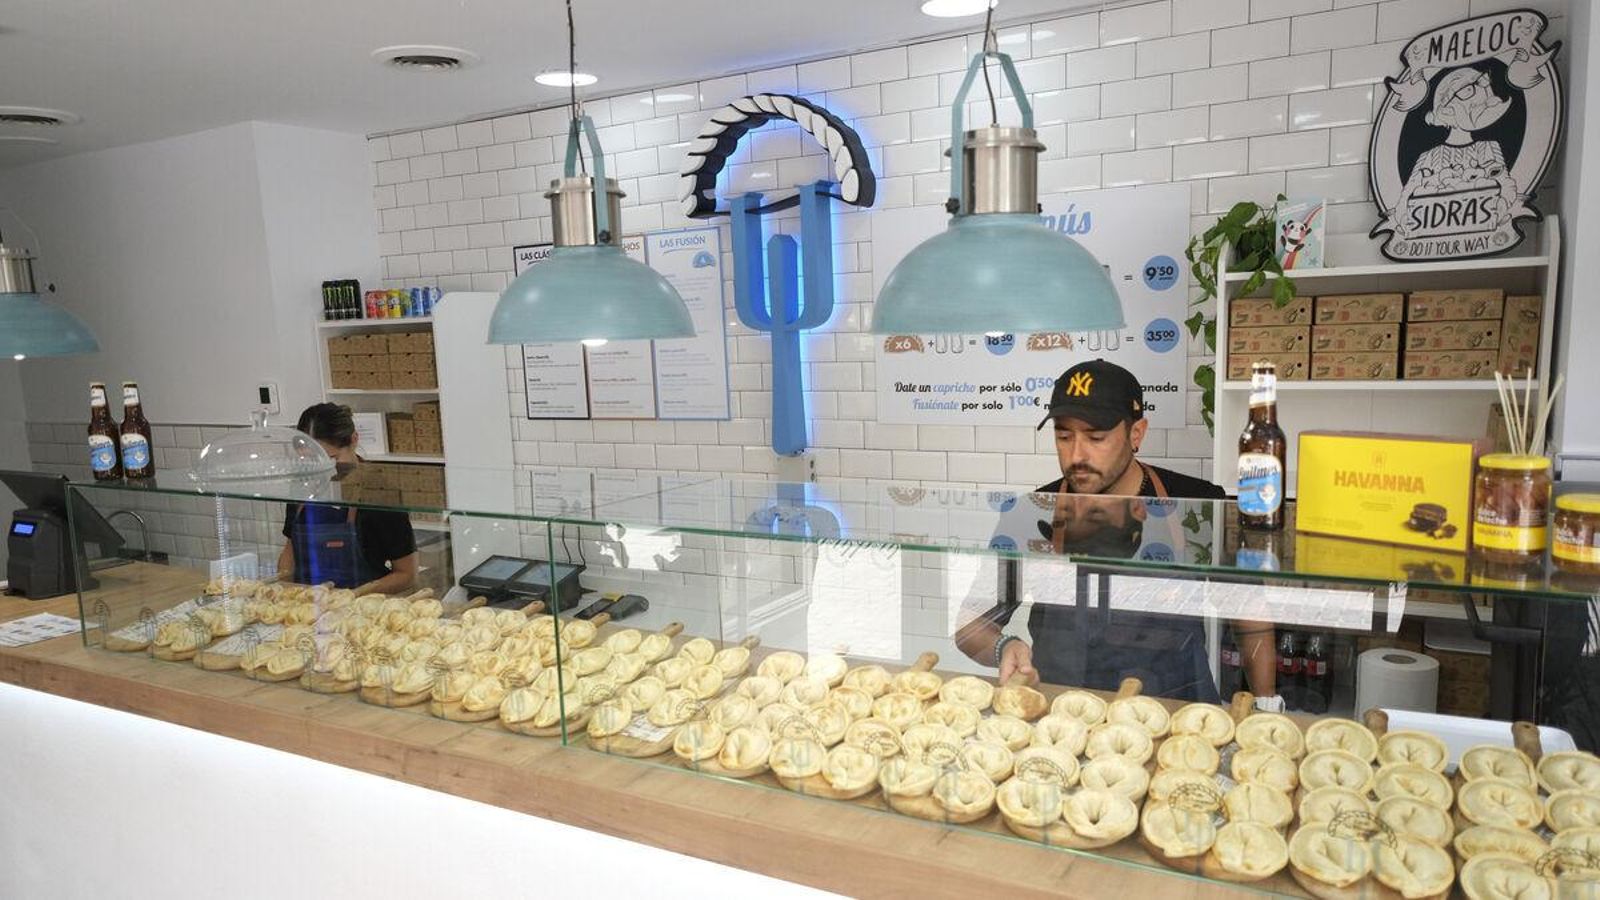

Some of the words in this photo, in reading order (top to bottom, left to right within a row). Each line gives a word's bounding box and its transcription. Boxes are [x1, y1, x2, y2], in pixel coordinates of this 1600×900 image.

[1427, 15, 1522, 64] MAELOC
[1040, 203, 1092, 235] nús
[1411, 196, 1493, 231] SIDRAS
[659, 238, 675, 249] LAS
[675, 235, 706, 246] FUSIÓN
[1409, 242, 1424, 257] DO
[1436, 240, 1461, 256] YOUR
[1464, 236, 1490, 252] WAY
[520, 253, 534, 261] LAS
[533, 248, 551, 259] CLÁS
[895, 342, 912, 350] x6
[1036, 335, 1062, 348] x12
[894, 382, 917, 392] Date
[919, 384, 931, 392] un
[933, 382, 976, 395] capricho
[980, 385, 997, 394] por
[1000, 382, 1022, 392] sólo
[1066, 372, 1093, 396] NY
[961, 402, 979, 411] por
[982, 401, 1003, 410] solo
[1334, 470, 1425, 494] HAVANNA
